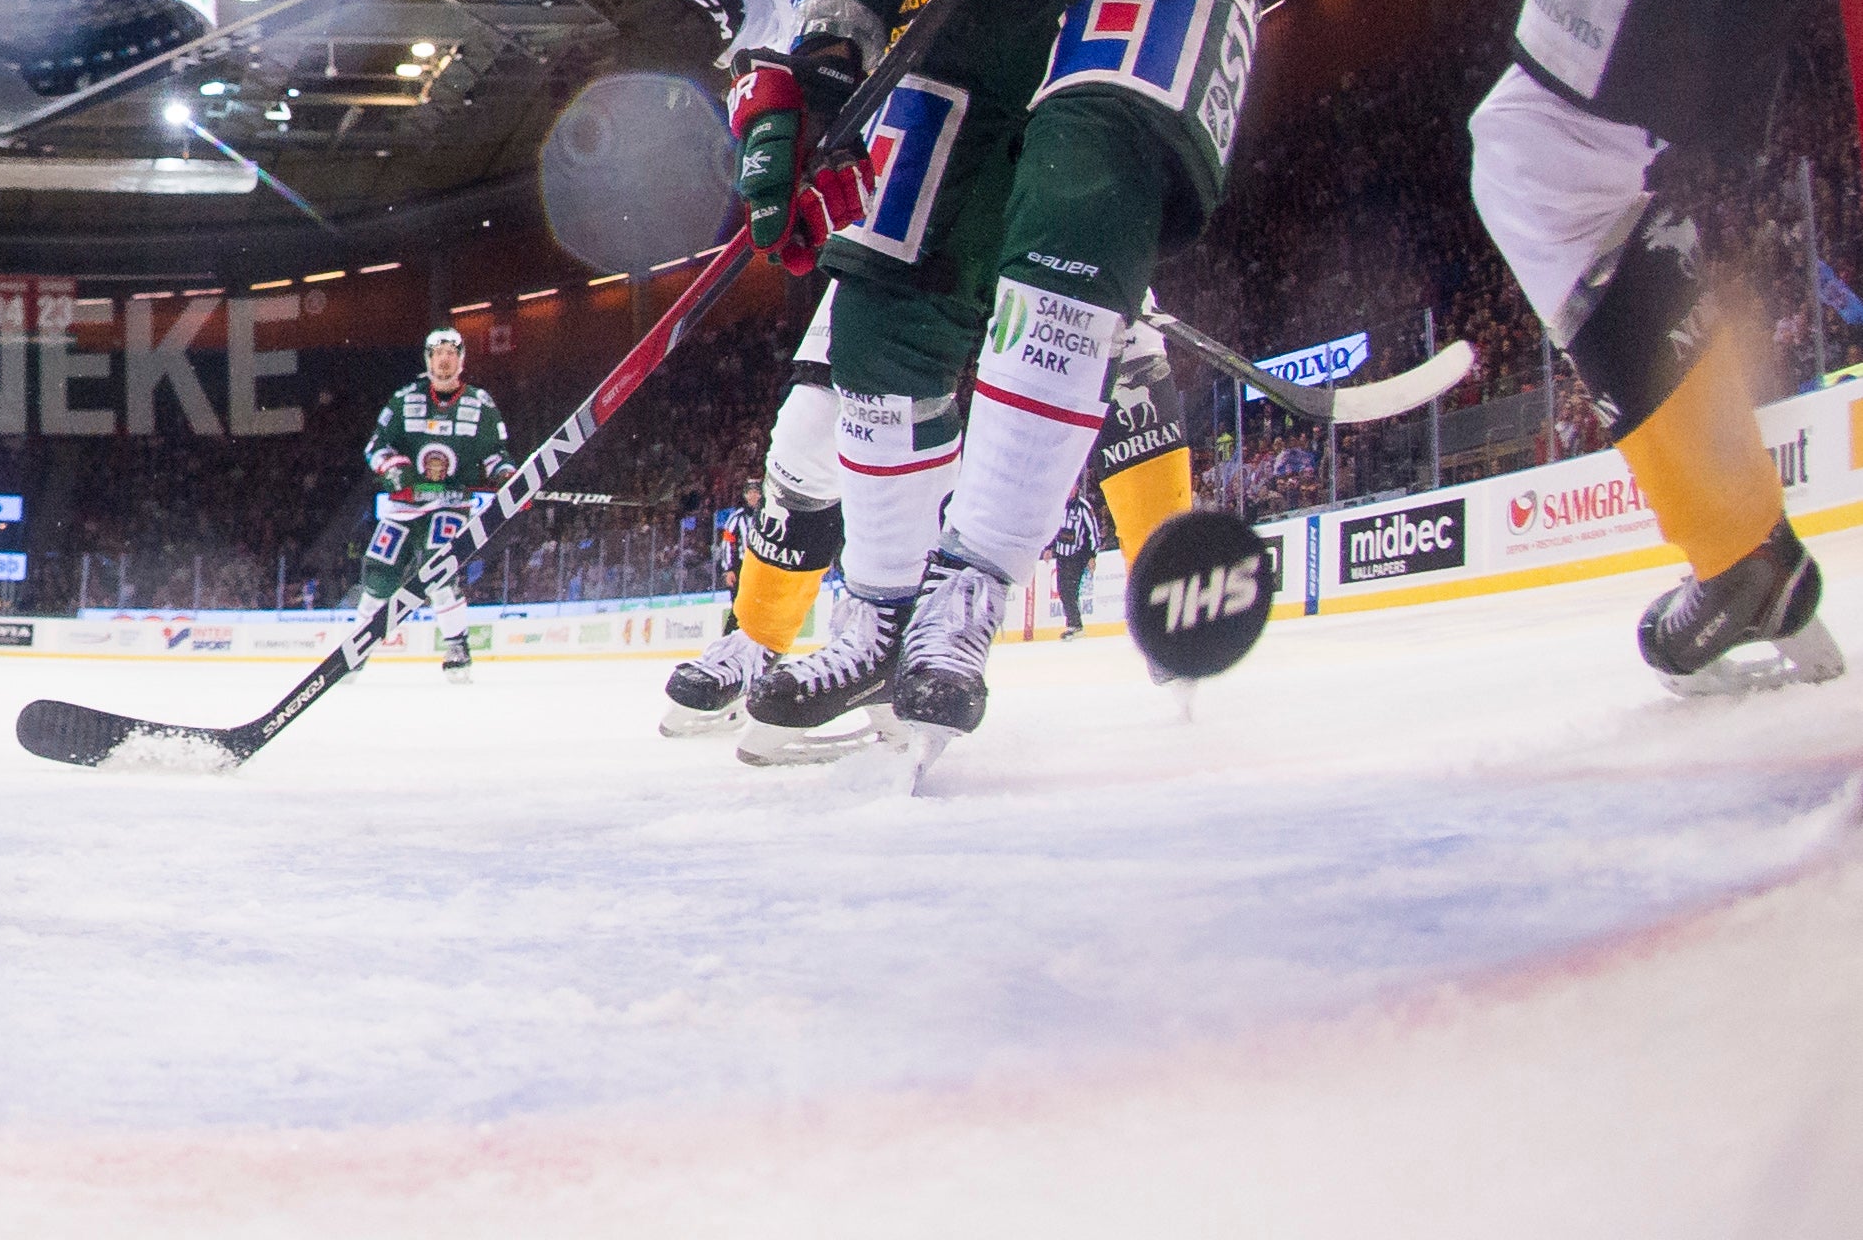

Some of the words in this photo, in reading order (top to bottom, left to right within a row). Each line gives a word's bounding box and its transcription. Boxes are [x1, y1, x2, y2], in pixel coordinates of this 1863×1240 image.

[1027, 251, 1100, 278] BAUER
[1036, 296, 1095, 331] SANKT
[1028, 319, 1101, 360] JÖRGEN
[1021, 344, 1072, 376] PARK
[1100, 420, 1181, 469] NORRAN
[535, 490, 613, 505] EASTON
[339, 415, 586, 671] EASTON
[748, 527, 806, 566] ORRAN
[1350, 513, 1454, 563] midbec
[1350, 559, 1407, 580] WALLPAPERS
[261, 673, 326, 739] SYNERGY
